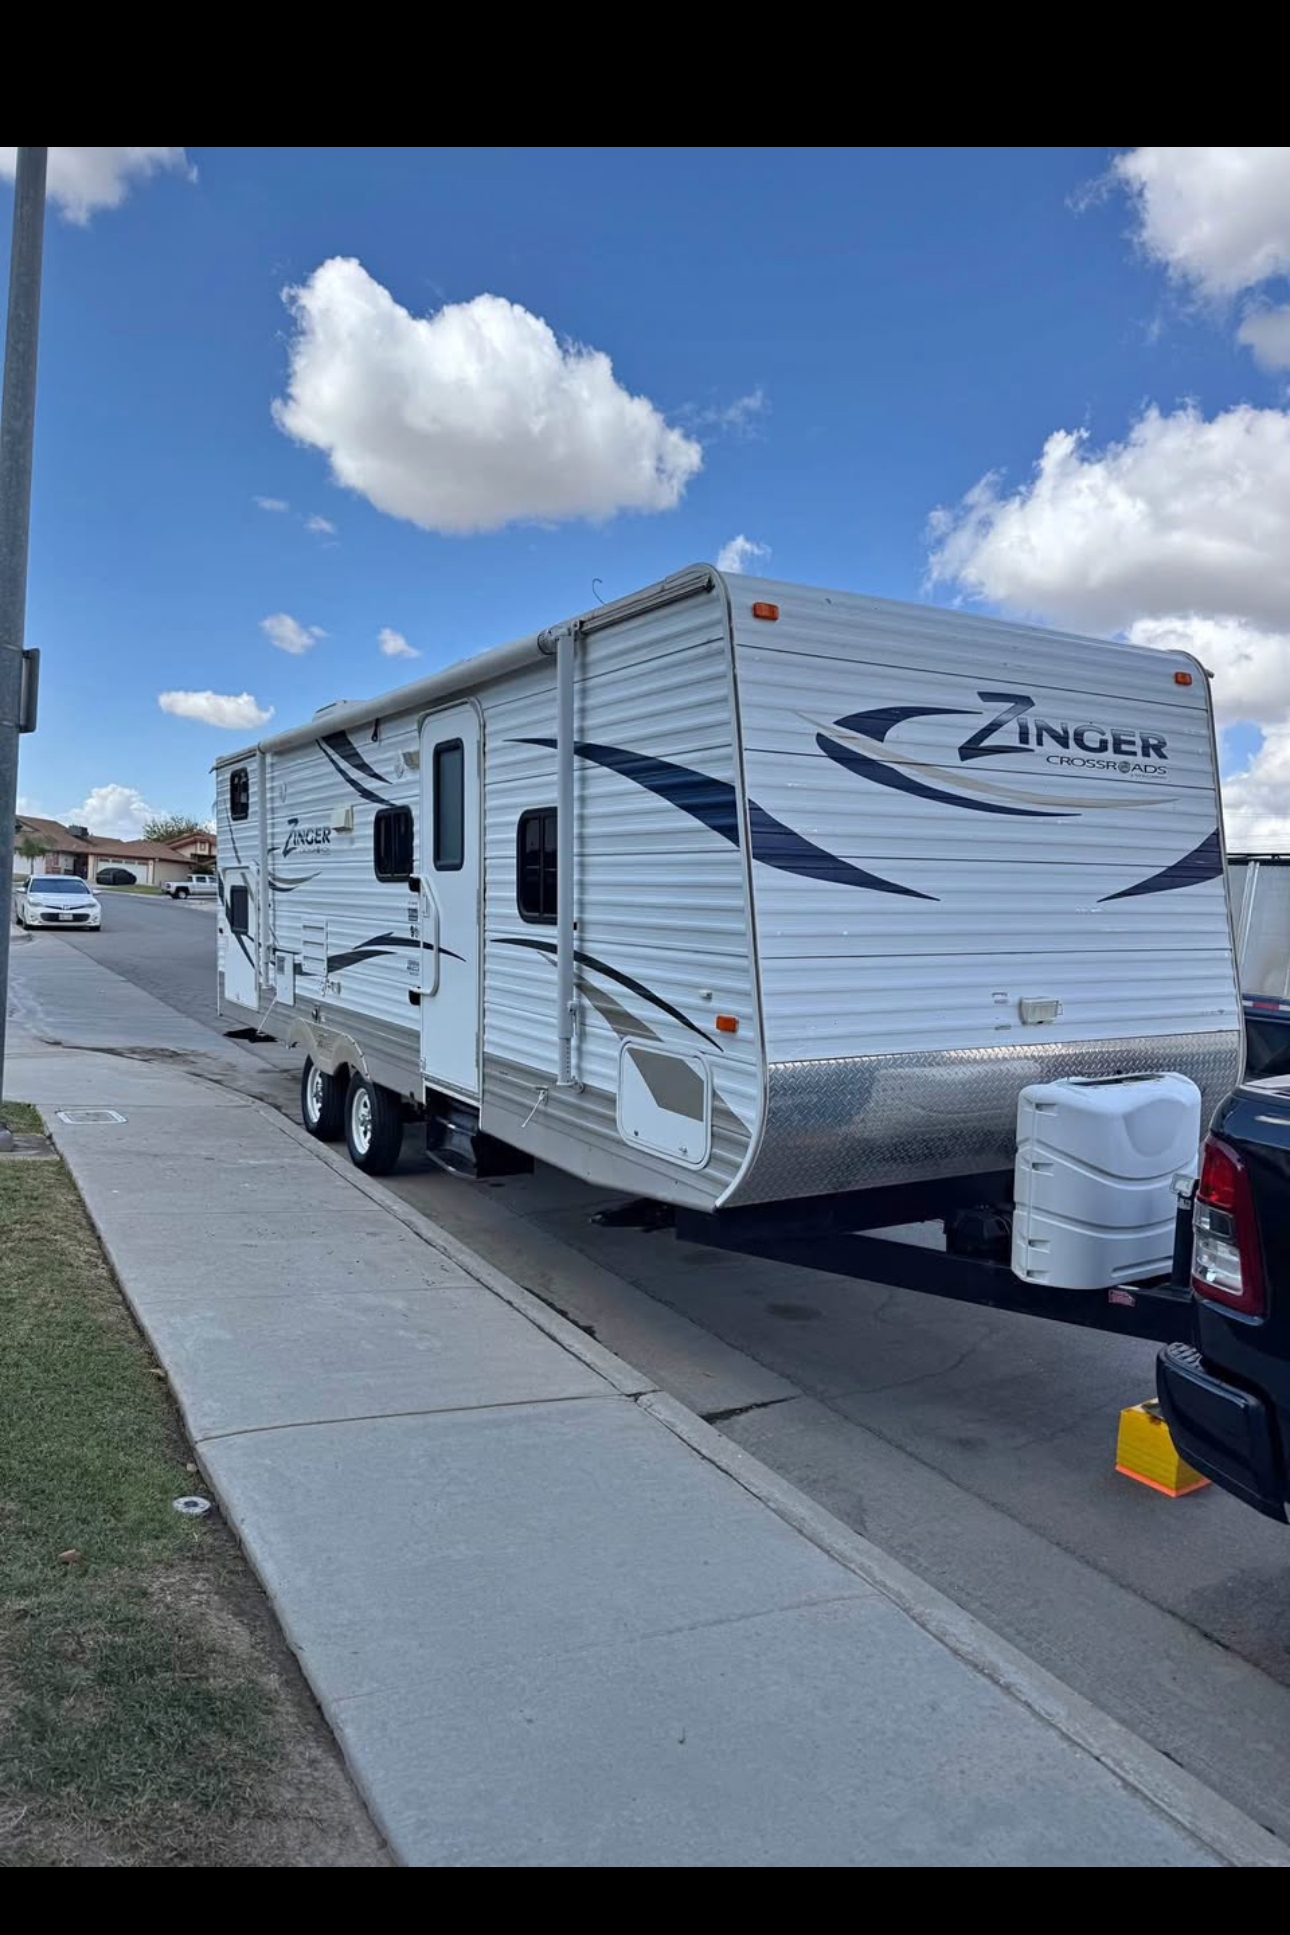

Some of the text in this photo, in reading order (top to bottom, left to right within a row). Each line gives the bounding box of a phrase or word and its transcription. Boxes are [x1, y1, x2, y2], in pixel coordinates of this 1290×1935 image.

[958, 691, 1168, 762] ZINGER
[1046, 755, 1167, 775] CROSSROADS
[282, 818, 331, 858] ZINGER
